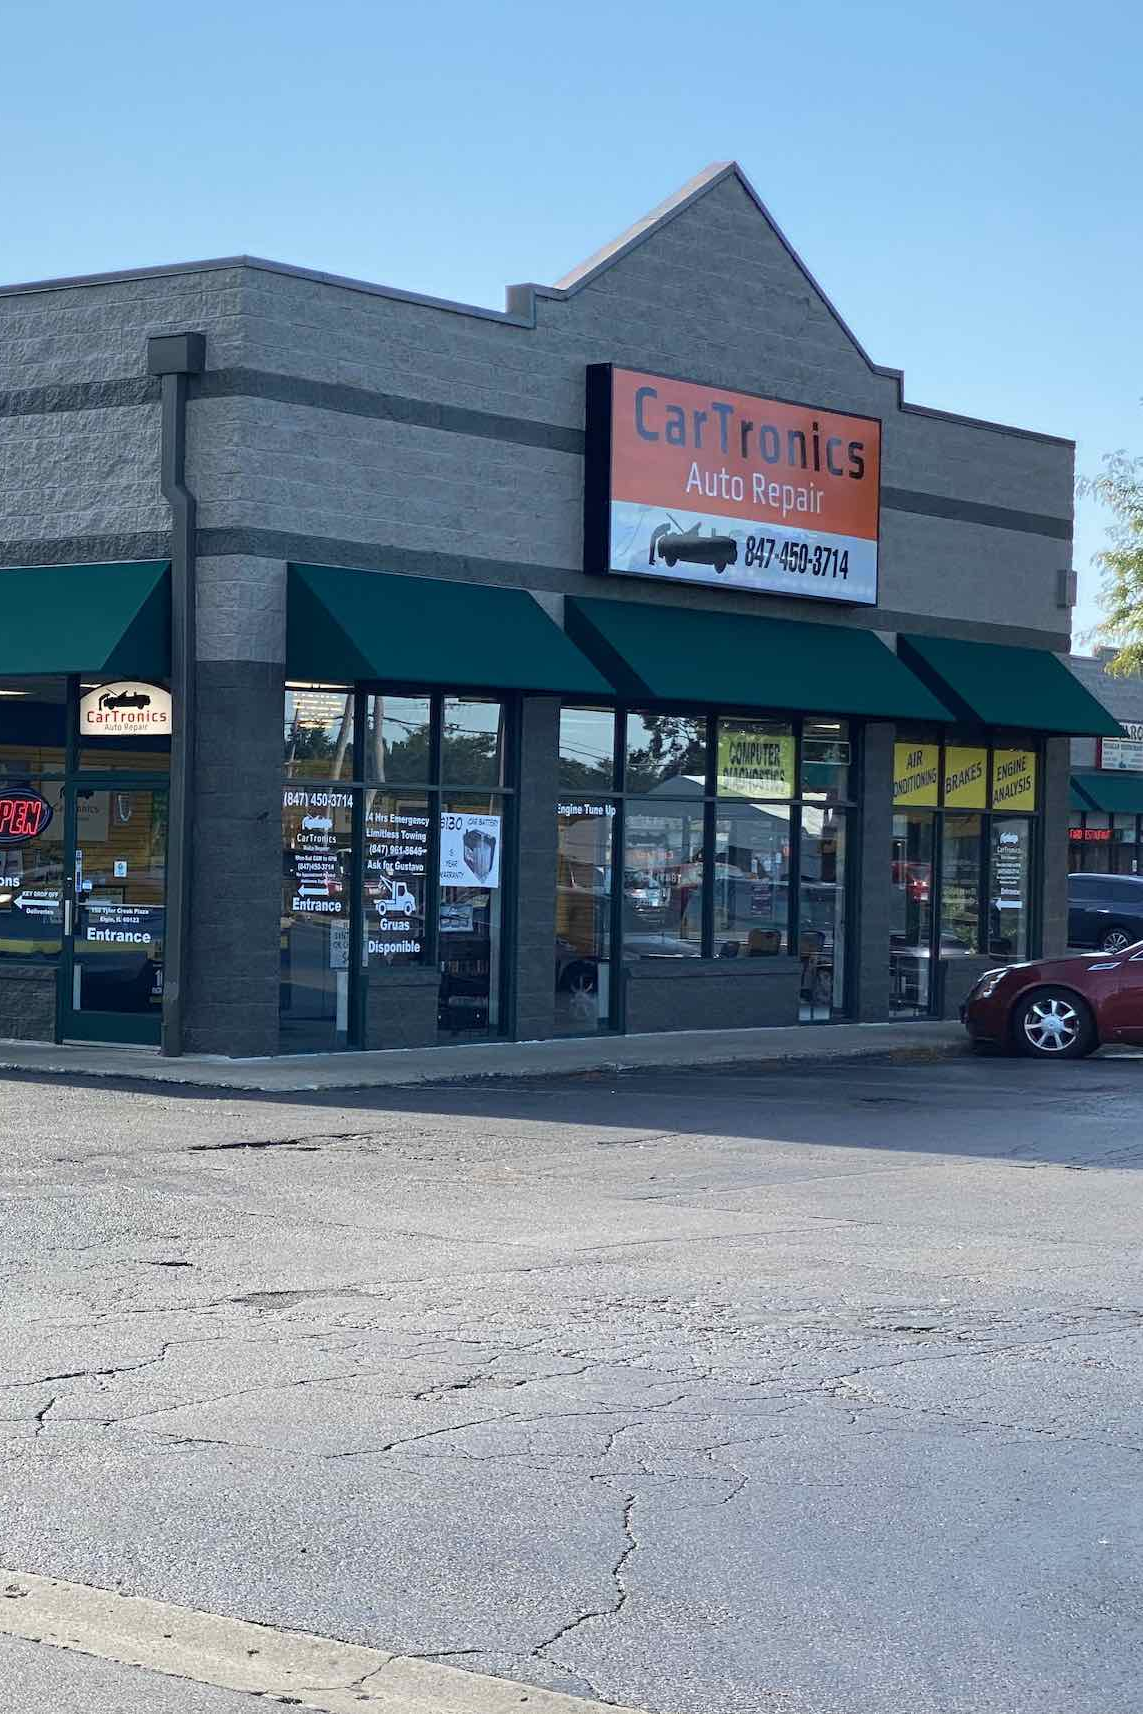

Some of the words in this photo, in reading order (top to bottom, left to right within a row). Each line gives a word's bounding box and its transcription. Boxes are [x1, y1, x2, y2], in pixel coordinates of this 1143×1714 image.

[634, 386, 865, 480] CarTronics
[686, 461, 744, 502] Auto
[752, 472, 824, 518] Repair
[745, 535, 849, 579] 847-450-3714
[87, 710, 167, 723] CarTronics
[105, 723, 122, 731] Auto
[124, 723, 148, 732] Repair
[729, 741, 781, 766] COMPUTER
[906, 750, 923, 769] AIR
[997, 756, 1026, 782] ENGINE
[892, 767, 937, 798] ONDITIONING
[945, 762, 982, 794] BRAKES
[993, 776, 1032, 804] ANALYSIS
[283, 791, 308, 807] (847)
[311, 793, 353, 808] 450-3714
[584, 803, 604, 816] Tune
[605, 805, 616, 817] Up
[375, 812, 388, 823] Hrs
[390, 813, 429, 827] Emergency
[297, 833, 337, 843] CarTronics
[366, 828, 399, 839] Limitless
[401, 830, 426, 842] Towing
[369, 844, 388, 856] (847)
[367, 860, 381, 869] Ask
[383, 860, 393, 870] for
[395, 861, 424, 871] Gustavo
[292, 896, 342, 912] Entrance
[380, 918, 410, 931] Gruas
[87, 927, 151, 943] Entrance
[368, 940, 420, 956] Disponible
